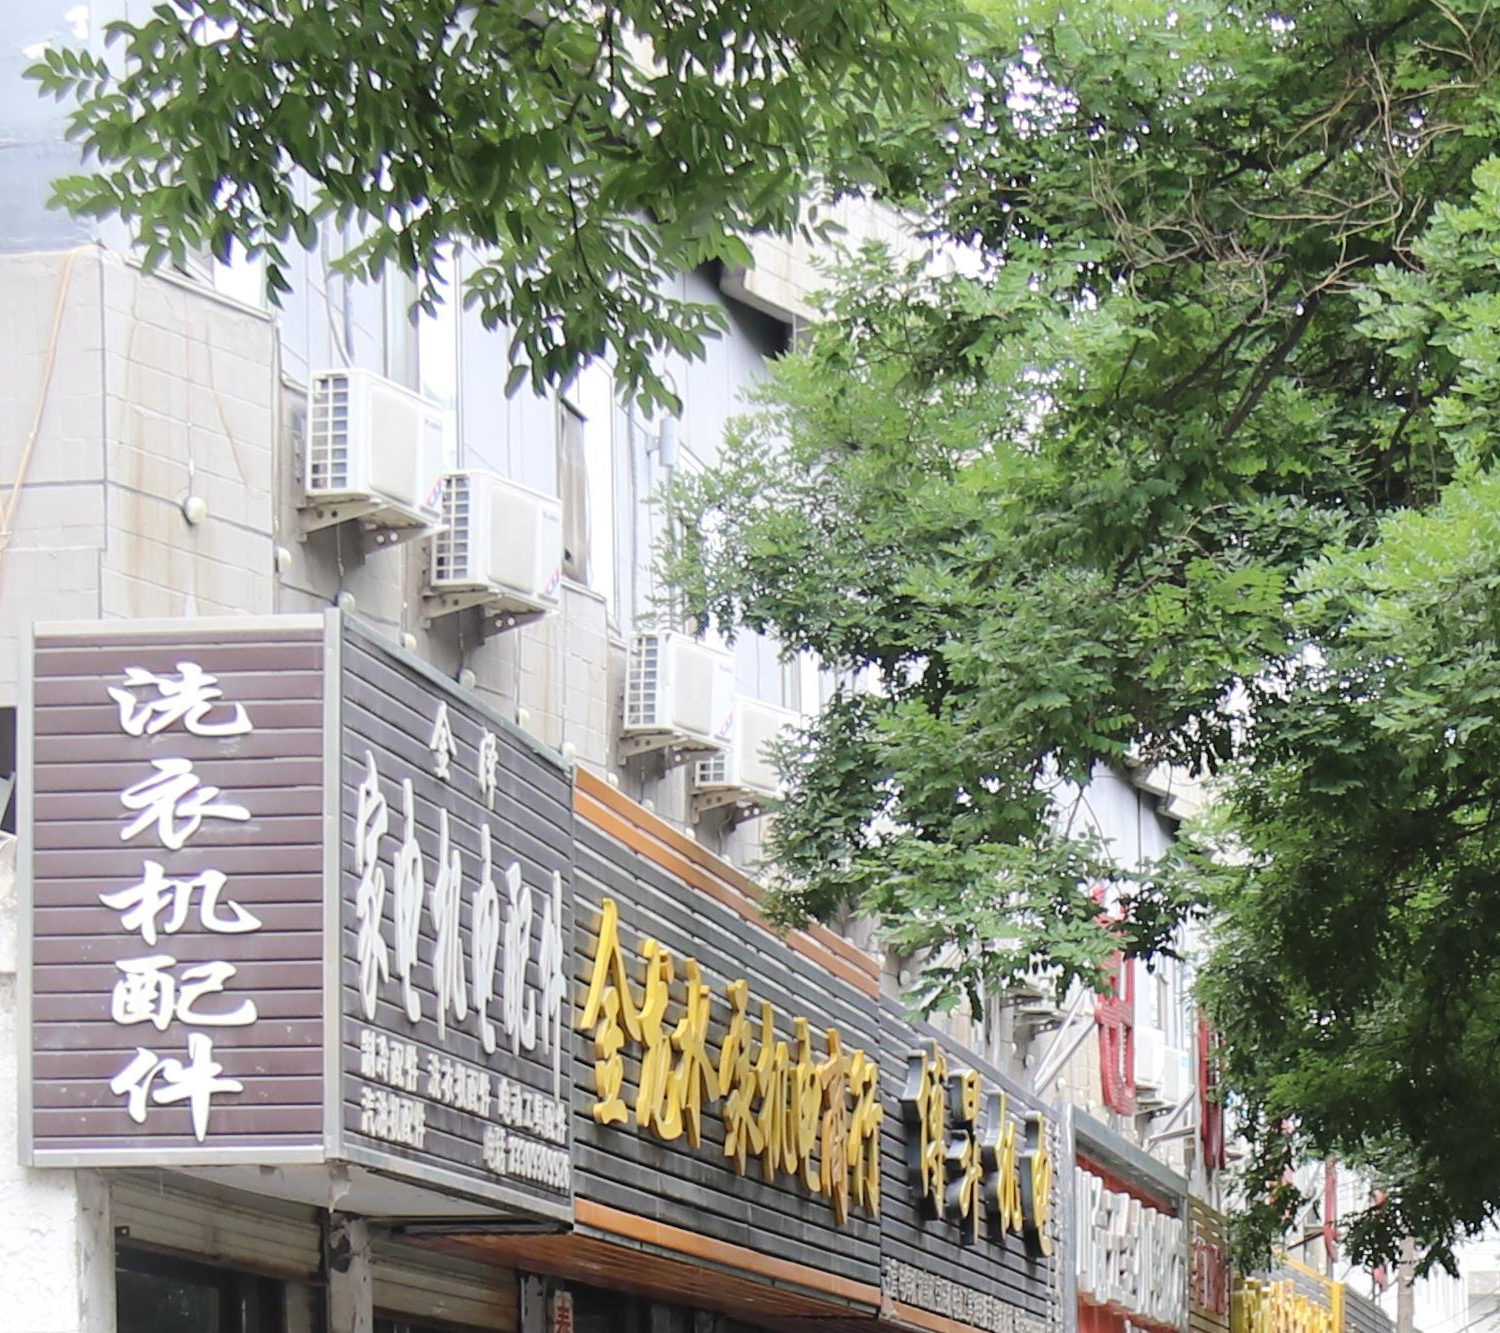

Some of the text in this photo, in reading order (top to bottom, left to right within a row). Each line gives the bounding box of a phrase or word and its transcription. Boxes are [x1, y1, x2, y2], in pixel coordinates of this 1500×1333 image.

[100, 661, 263, 1142] 洗衣机配件
[429, 701, 499, 810] 金牌
